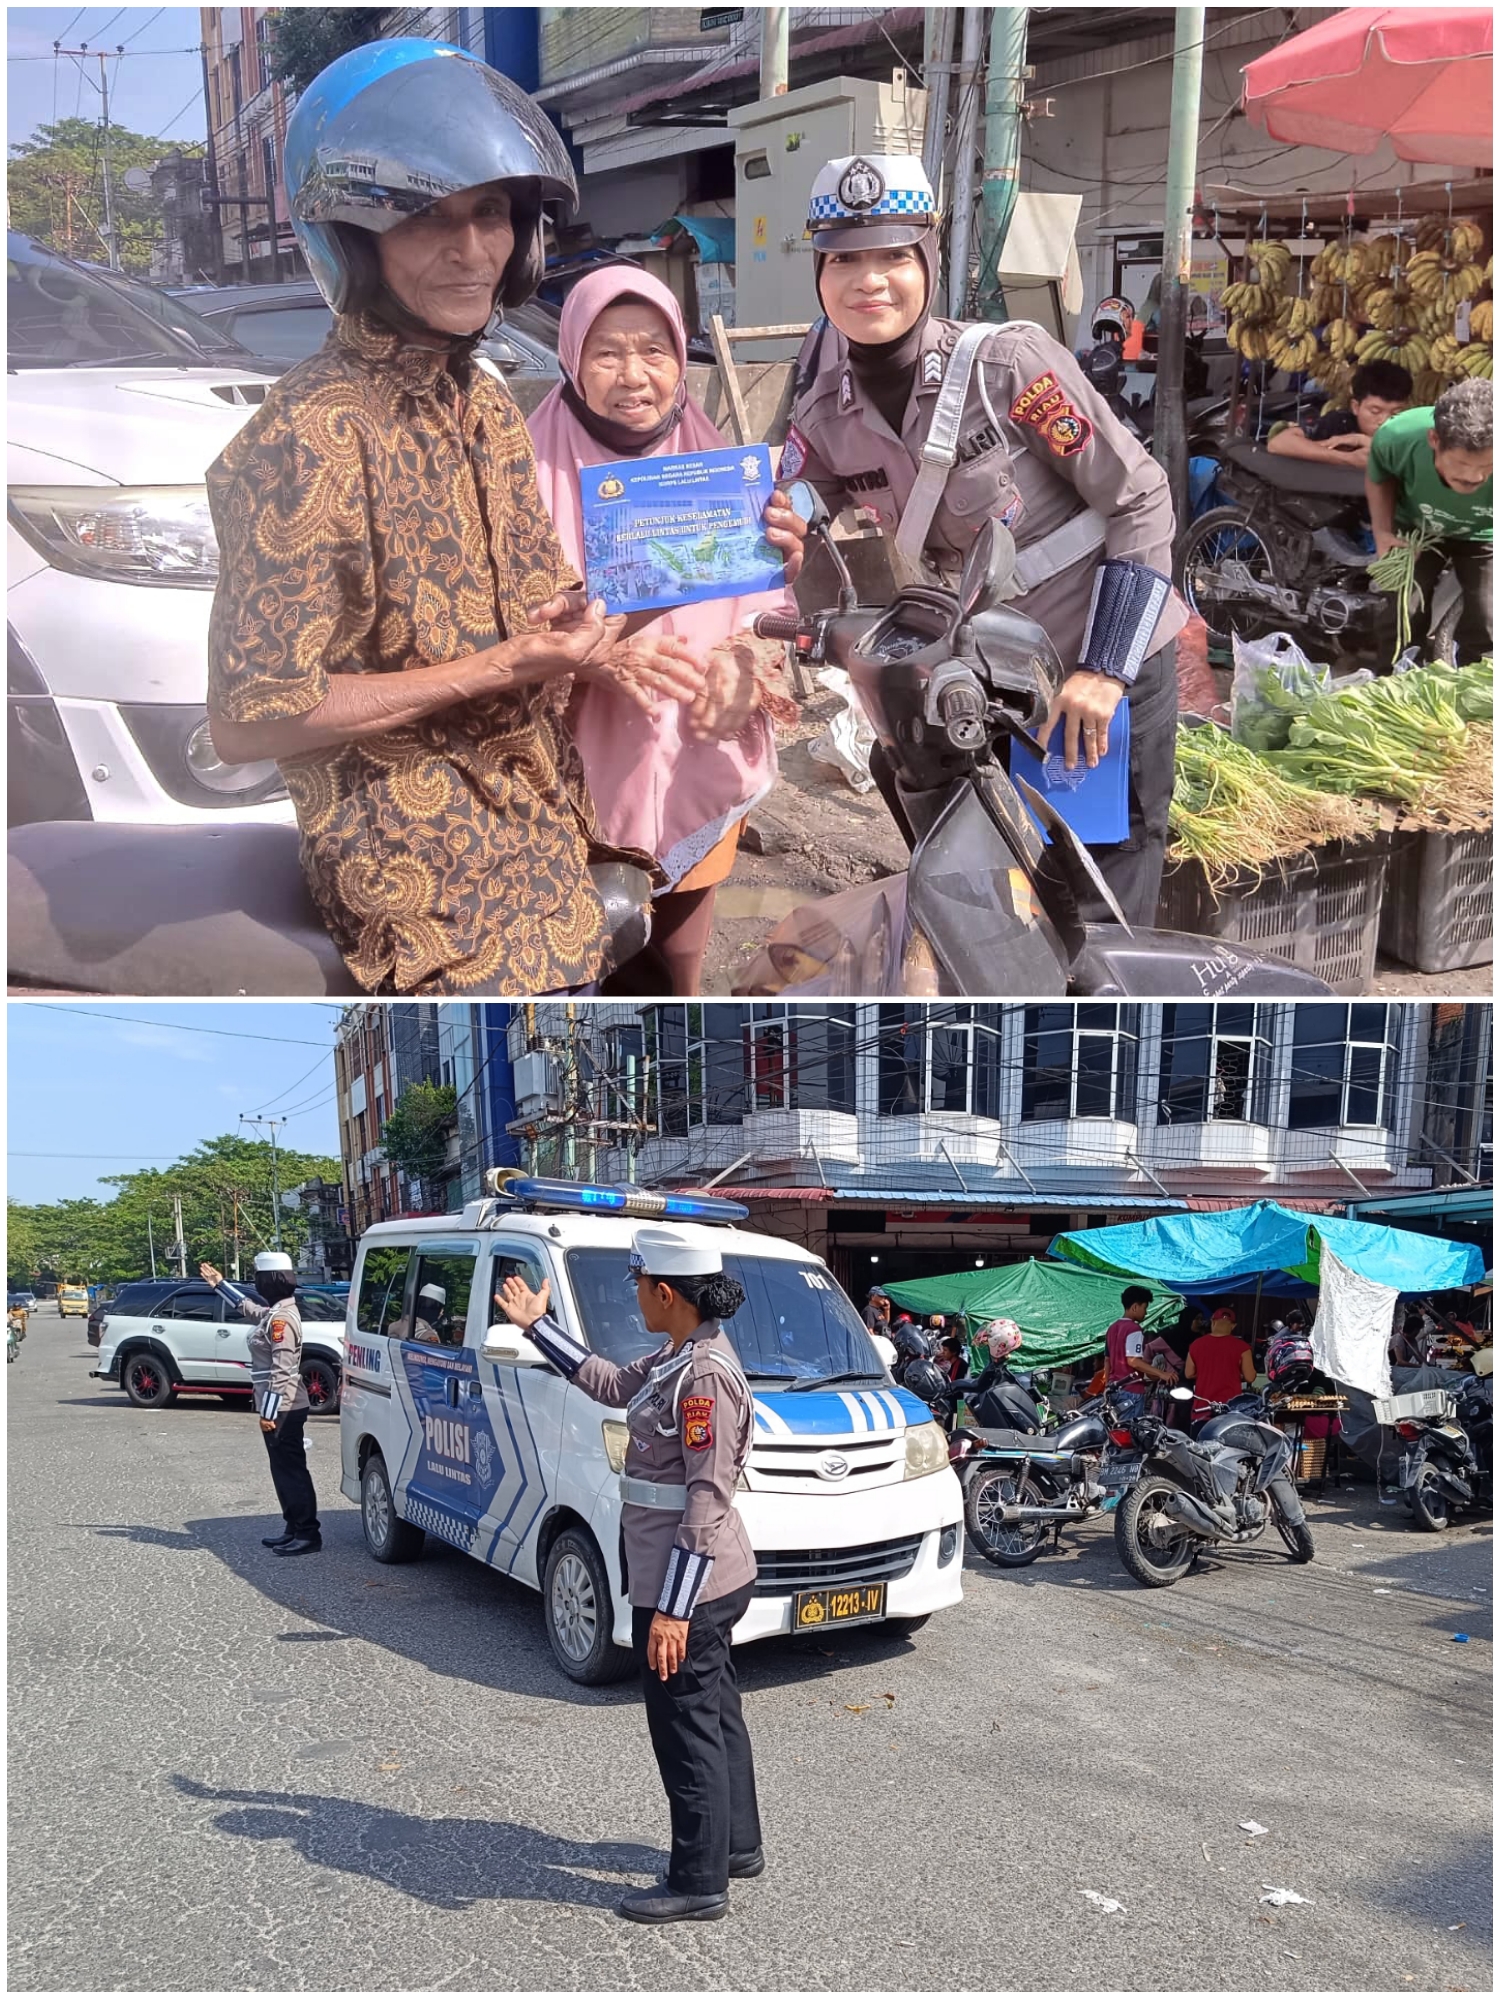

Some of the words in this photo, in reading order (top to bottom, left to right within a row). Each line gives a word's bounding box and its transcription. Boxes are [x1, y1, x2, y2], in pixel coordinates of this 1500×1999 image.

[1014, 376, 1054, 416] POLDA
[1030, 394, 1061, 422] RIAU
[616, 530, 651, 542] BERLALU
[651, 526, 680, 537] LINTAS
[681, 522, 707, 534] UNTUK
[708, 516, 751, 531] PENGEMUDI
[634, 515, 676, 528] PETUNJUK
[677, 507, 731, 521] KESELAMATAN
[798, 1270, 832, 1291] 701
[348, 1343, 381, 1373] PENLING
[1135, 1343, 1142, 1354] 8
[683, 1398, 711, 1409] POLDA
[425, 1415, 471, 1464] POLISI
[427, 1460, 444, 1476] LALU
[445, 1466, 471, 1486] LINTAS
